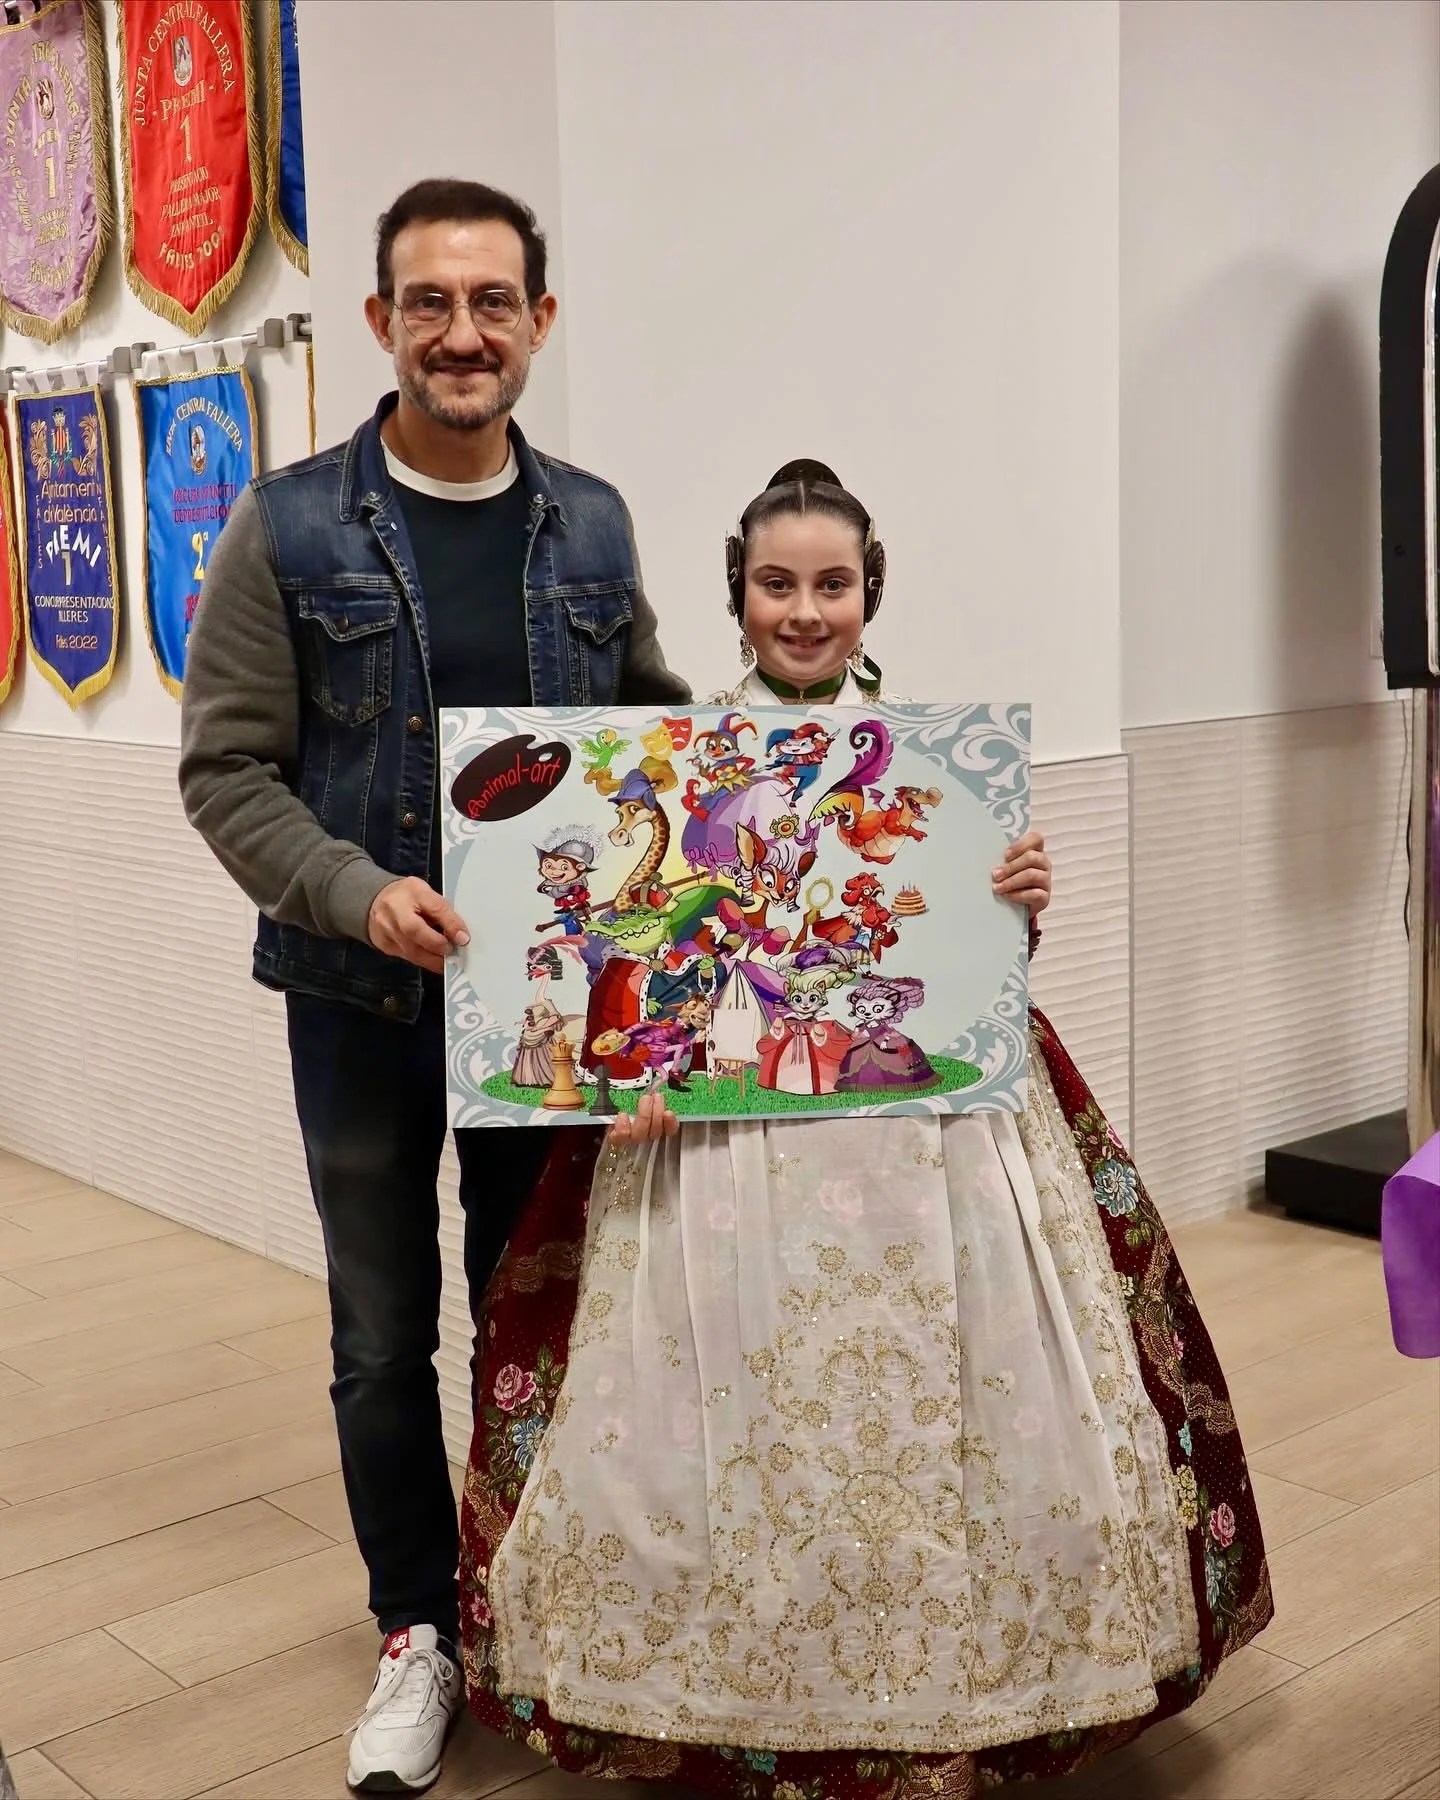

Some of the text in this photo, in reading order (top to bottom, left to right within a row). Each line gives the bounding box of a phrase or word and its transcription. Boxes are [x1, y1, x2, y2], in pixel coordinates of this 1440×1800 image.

[135, 56, 153, 126] JUNTA
[148, 0, 196, 52] CENTRAL
[194, 3, 236, 94] FALLERA
[180, 115, 193, 163] 1
[45, 156, 57, 200] 1
[206, 400, 243, 453] FALLERA
[61, 551, 71, 586] 1
[68, 635, 98, 649] 2022
[467, 752, 561, 819] Animal-art
